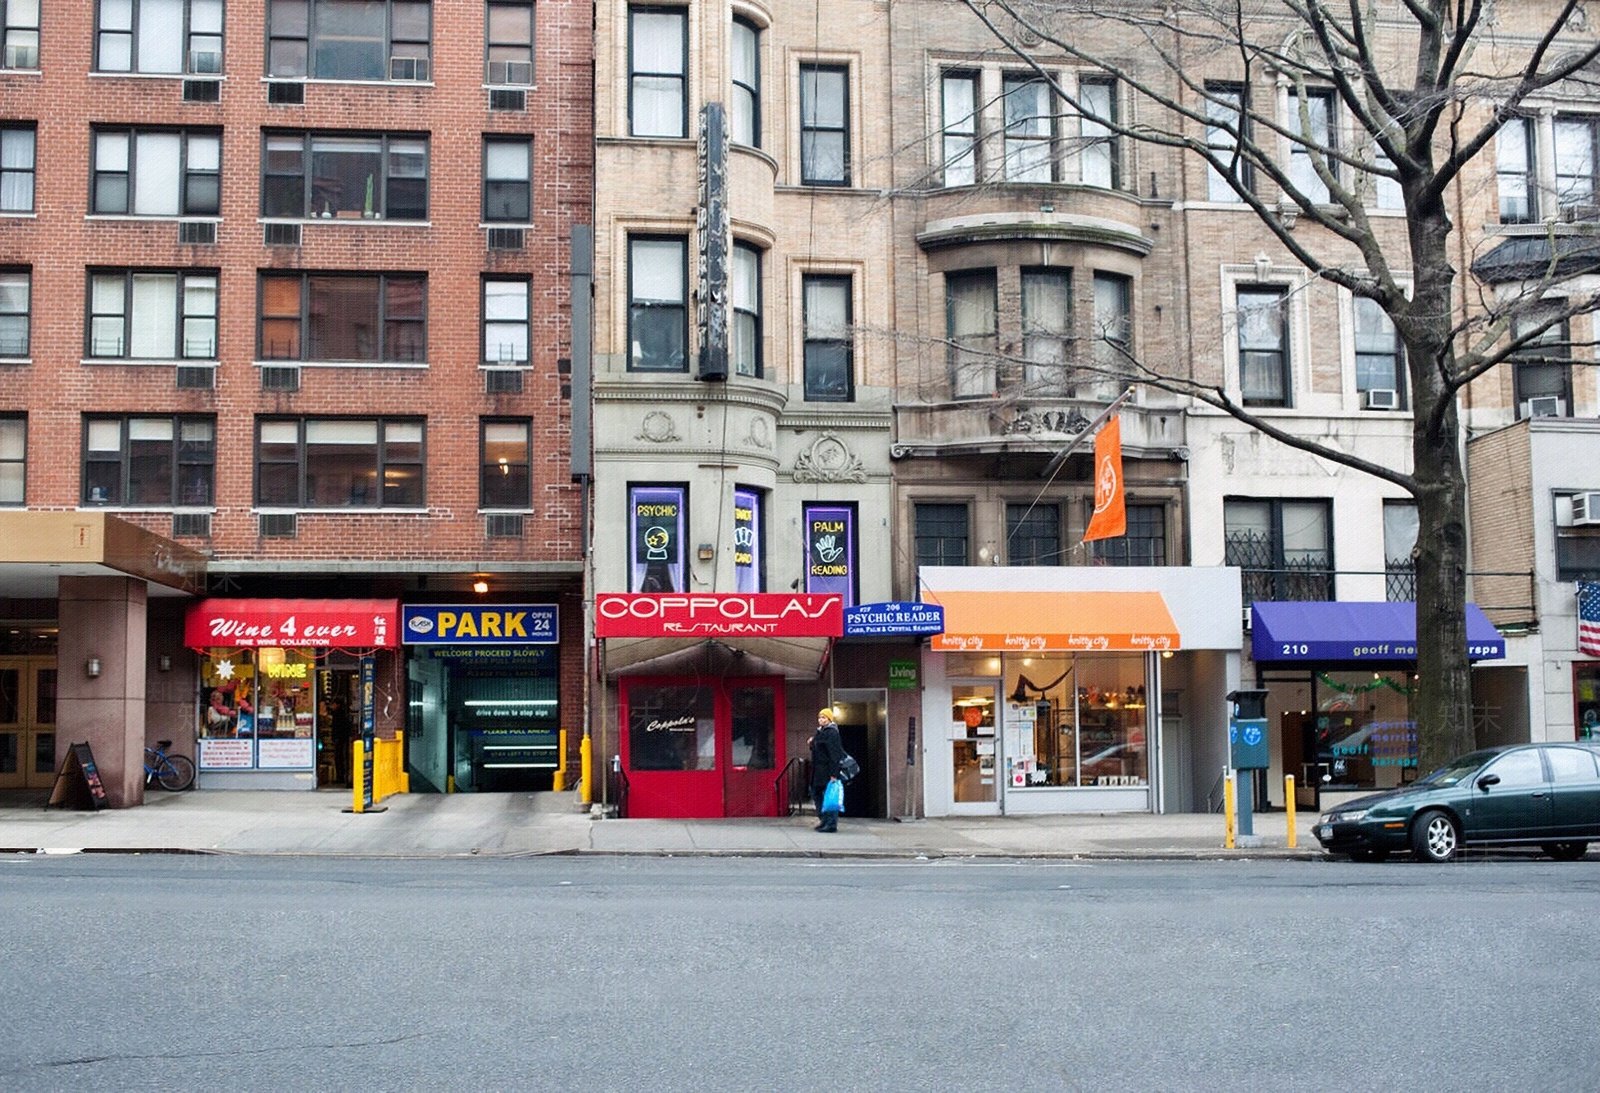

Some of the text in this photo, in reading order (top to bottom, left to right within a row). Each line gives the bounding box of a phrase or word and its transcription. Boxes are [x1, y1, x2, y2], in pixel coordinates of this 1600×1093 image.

[637, 505, 677, 517] PSYCHIC
[814, 521, 843, 533] PALM
[811, 565, 848, 576] READING
[600, 597, 840, 619] COPPOLA'S
[848, 612, 940, 624] PSYCHIC READER
[209, 616, 357, 637] Wine 4 ever
[438, 612, 528, 637] PARK
[534, 620, 550, 630] 24
[663, 622, 778, 633] RESTAURANT
[236, 638, 330, 646] FINE WINE COLLECTION
[942, 632, 983, 650] knitty city
[1005, 632, 1046, 650] knitty city
[1068, 632, 1108, 650] knitty city
[1130, 632, 1170, 650] knitty city
[1282, 645, 1308, 654] 210
[1353, 645, 1389, 656] geoff
[267, 663, 306, 678] WINE
[890, 666, 916, 679] Living
[1332, 744, 1368, 757] geoff
[1372, 757, 1418, 767] hairspa
